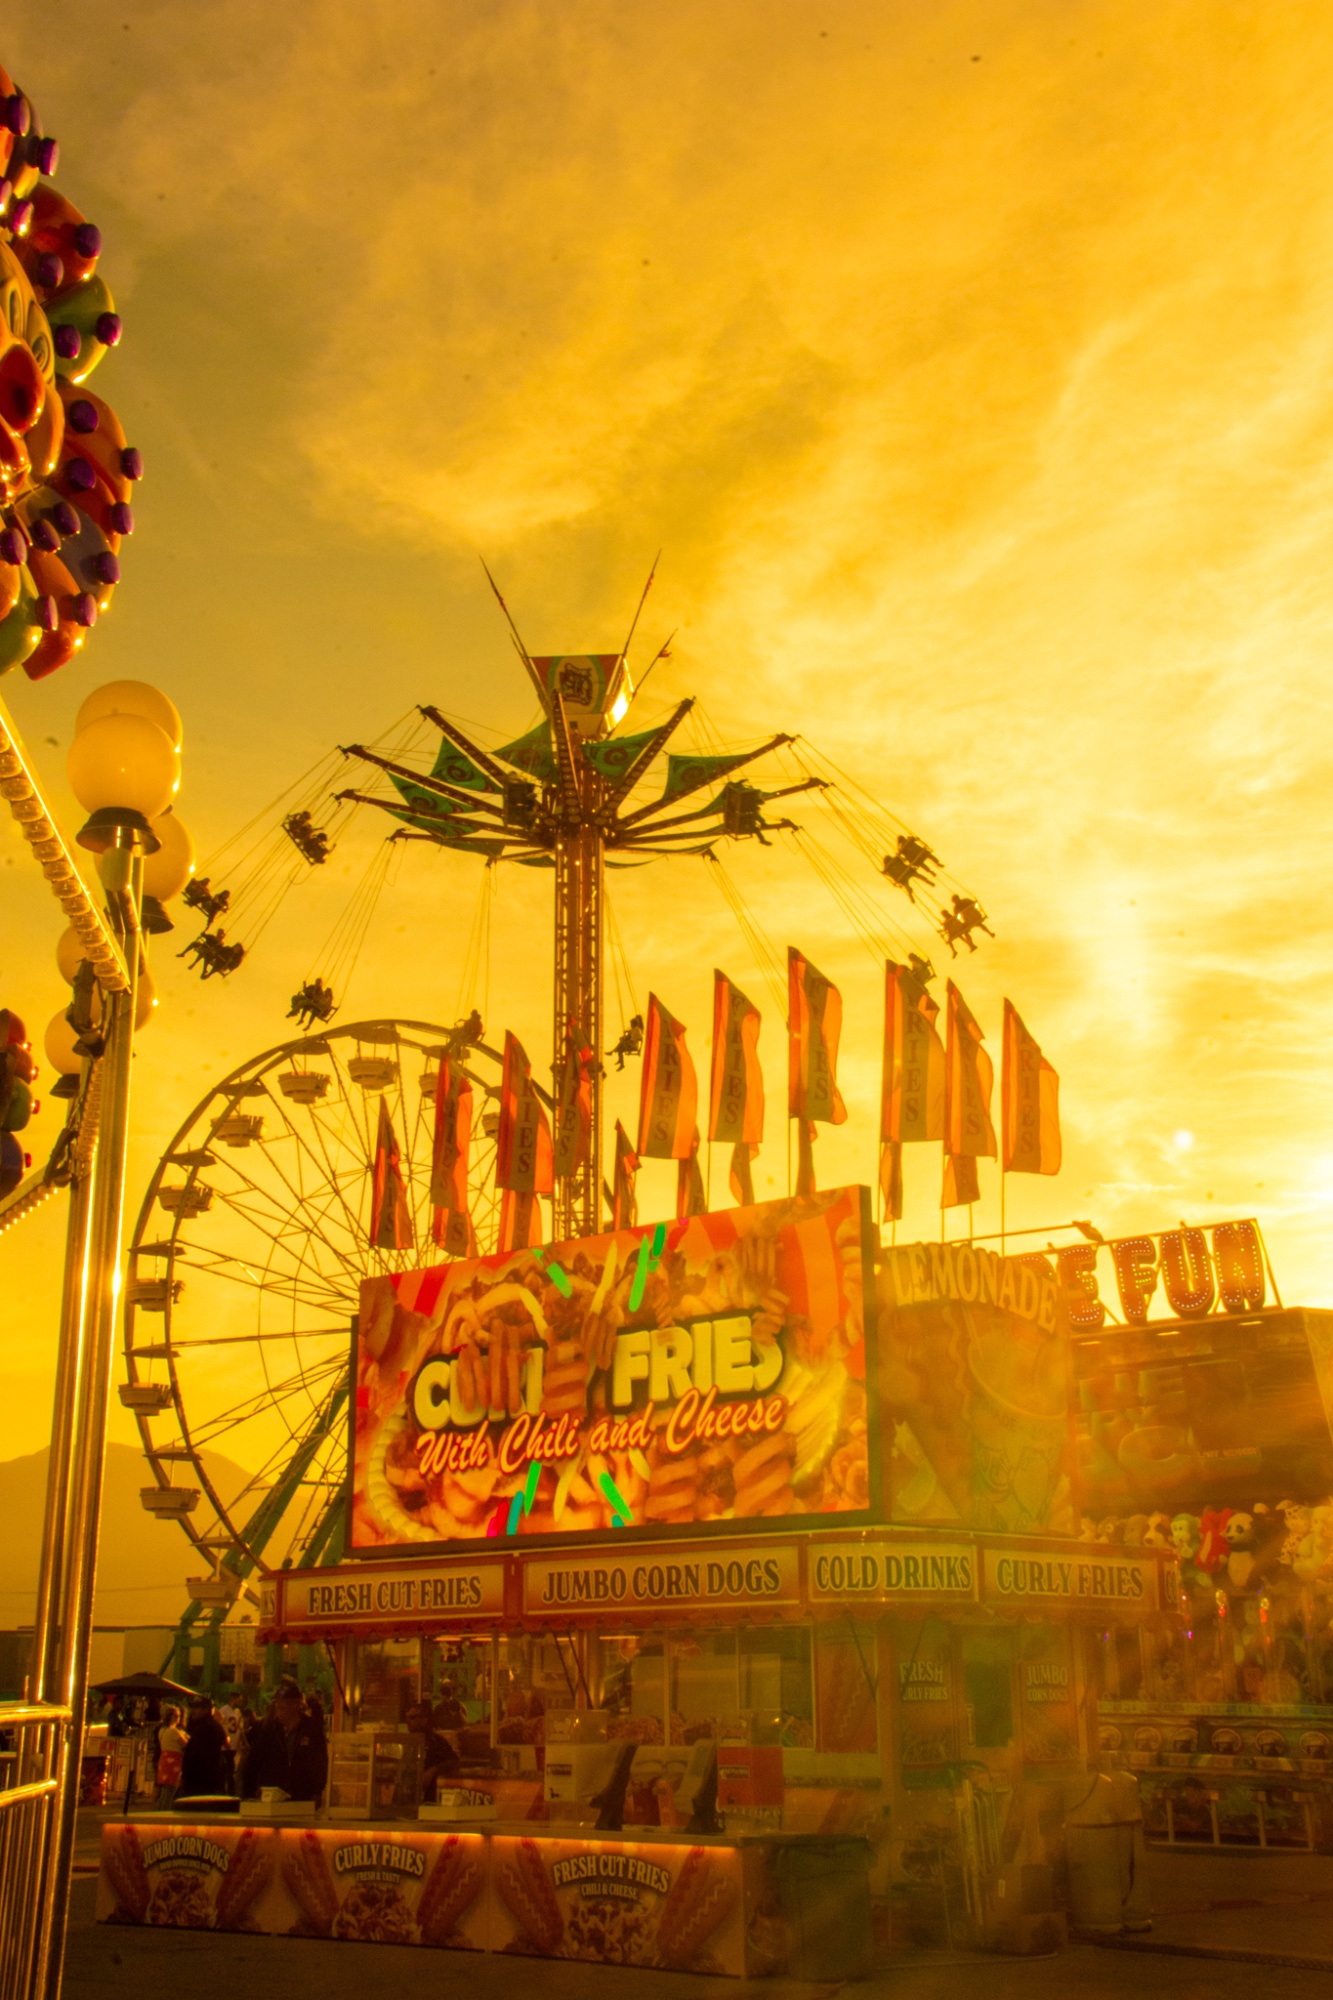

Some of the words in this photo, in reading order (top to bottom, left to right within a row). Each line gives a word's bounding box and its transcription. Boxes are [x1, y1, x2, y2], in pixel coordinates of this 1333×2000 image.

[886, 1243, 1058, 1334] LEMONADE
[1115, 1220, 1266, 1325] FUN
[416, 1420, 487, 1475] With
[500, 1411, 581, 1474] Chili
[590, 1401, 653, 1452] and
[665, 1387, 783, 1452] Cheese
[542, 1566, 628, 1604] JUMBO
[631, 1563, 700, 1601] CORN
[705, 1557, 782, 1596] DOGS
[815, 1552, 880, 1592] COLD
[884, 1554, 972, 1592] DRINKS
[996, 1556, 1076, 1596] CURLY
[1077, 1562, 1145, 1599] FRIES
[307, 1580, 375, 1615] FRESH
[376, 1578, 418, 1611] CUT
[418, 1574, 483, 1610] FRIES
[924, 1686, 949, 1701] FRIES
[1026, 1664, 1069, 1687] JUMBO
[176, 1836, 203, 1858] CORN
[202, 1840, 230, 1873] DOGS
[335, 1843, 380, 1872] CURLY
[382, 1843, 425, 1876] FRIES
[552, 1855, 598, 1886] FRESH
[599, 1854, 627, 1878] CUT
[627, 1857, 670, 1893] FRIES
[581, 1883, 600, 1897] CHILI
[608, 1883, 639, 1900] CHEESE
